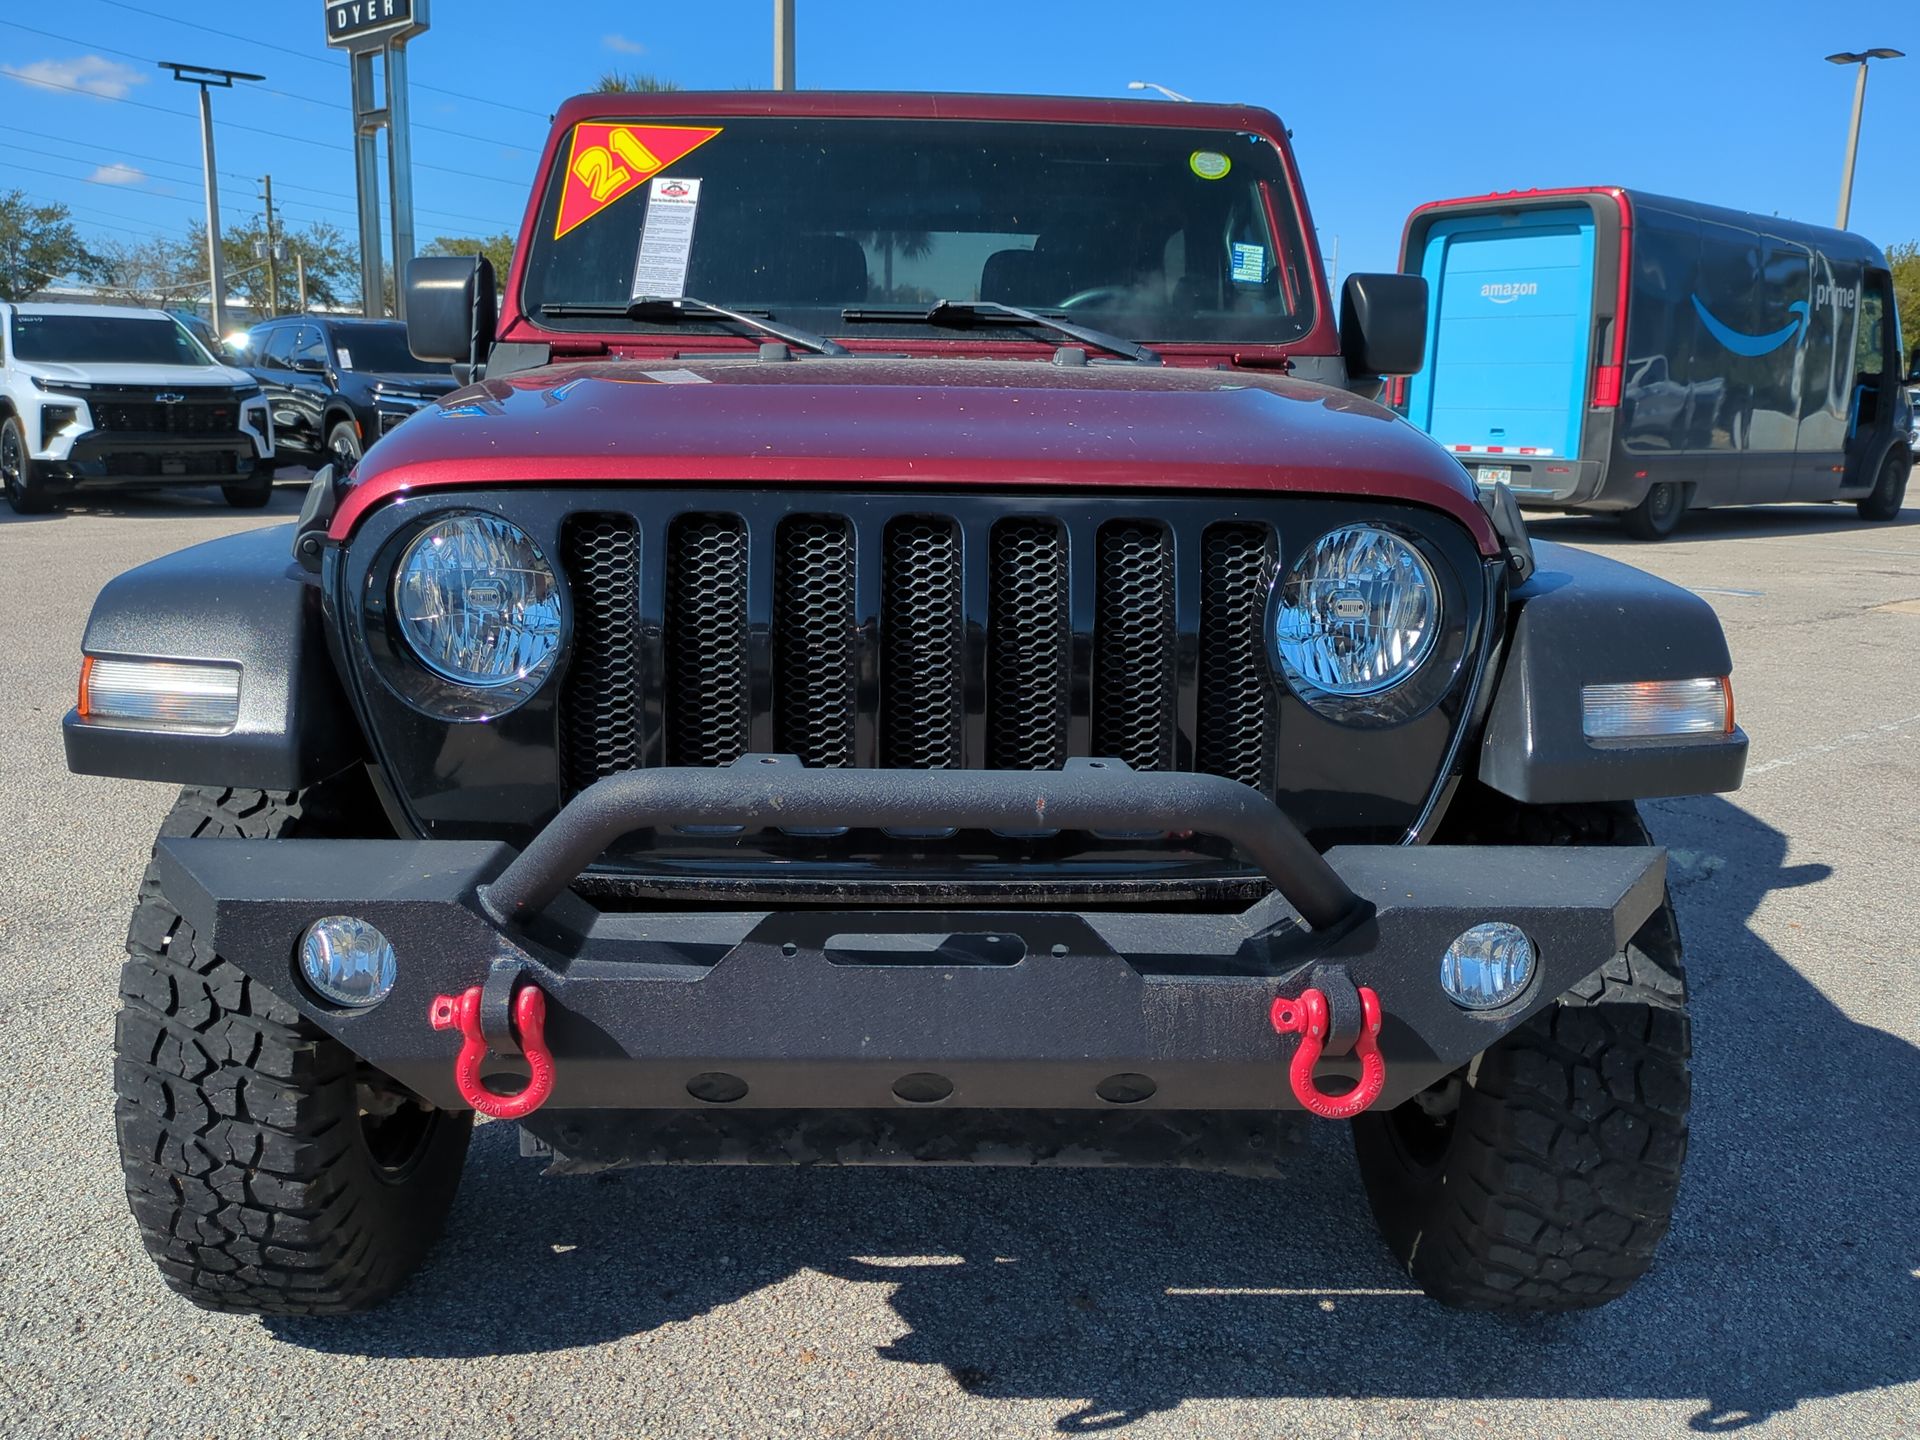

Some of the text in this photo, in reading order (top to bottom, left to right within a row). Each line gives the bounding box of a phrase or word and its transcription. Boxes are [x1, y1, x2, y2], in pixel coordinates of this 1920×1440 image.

[337, 0, 394, 29] DYER
[573, 128, 662, 202] 21
[1480, 282, 1538, 297] amazon
[1816, 279, 1854, 311] prime
